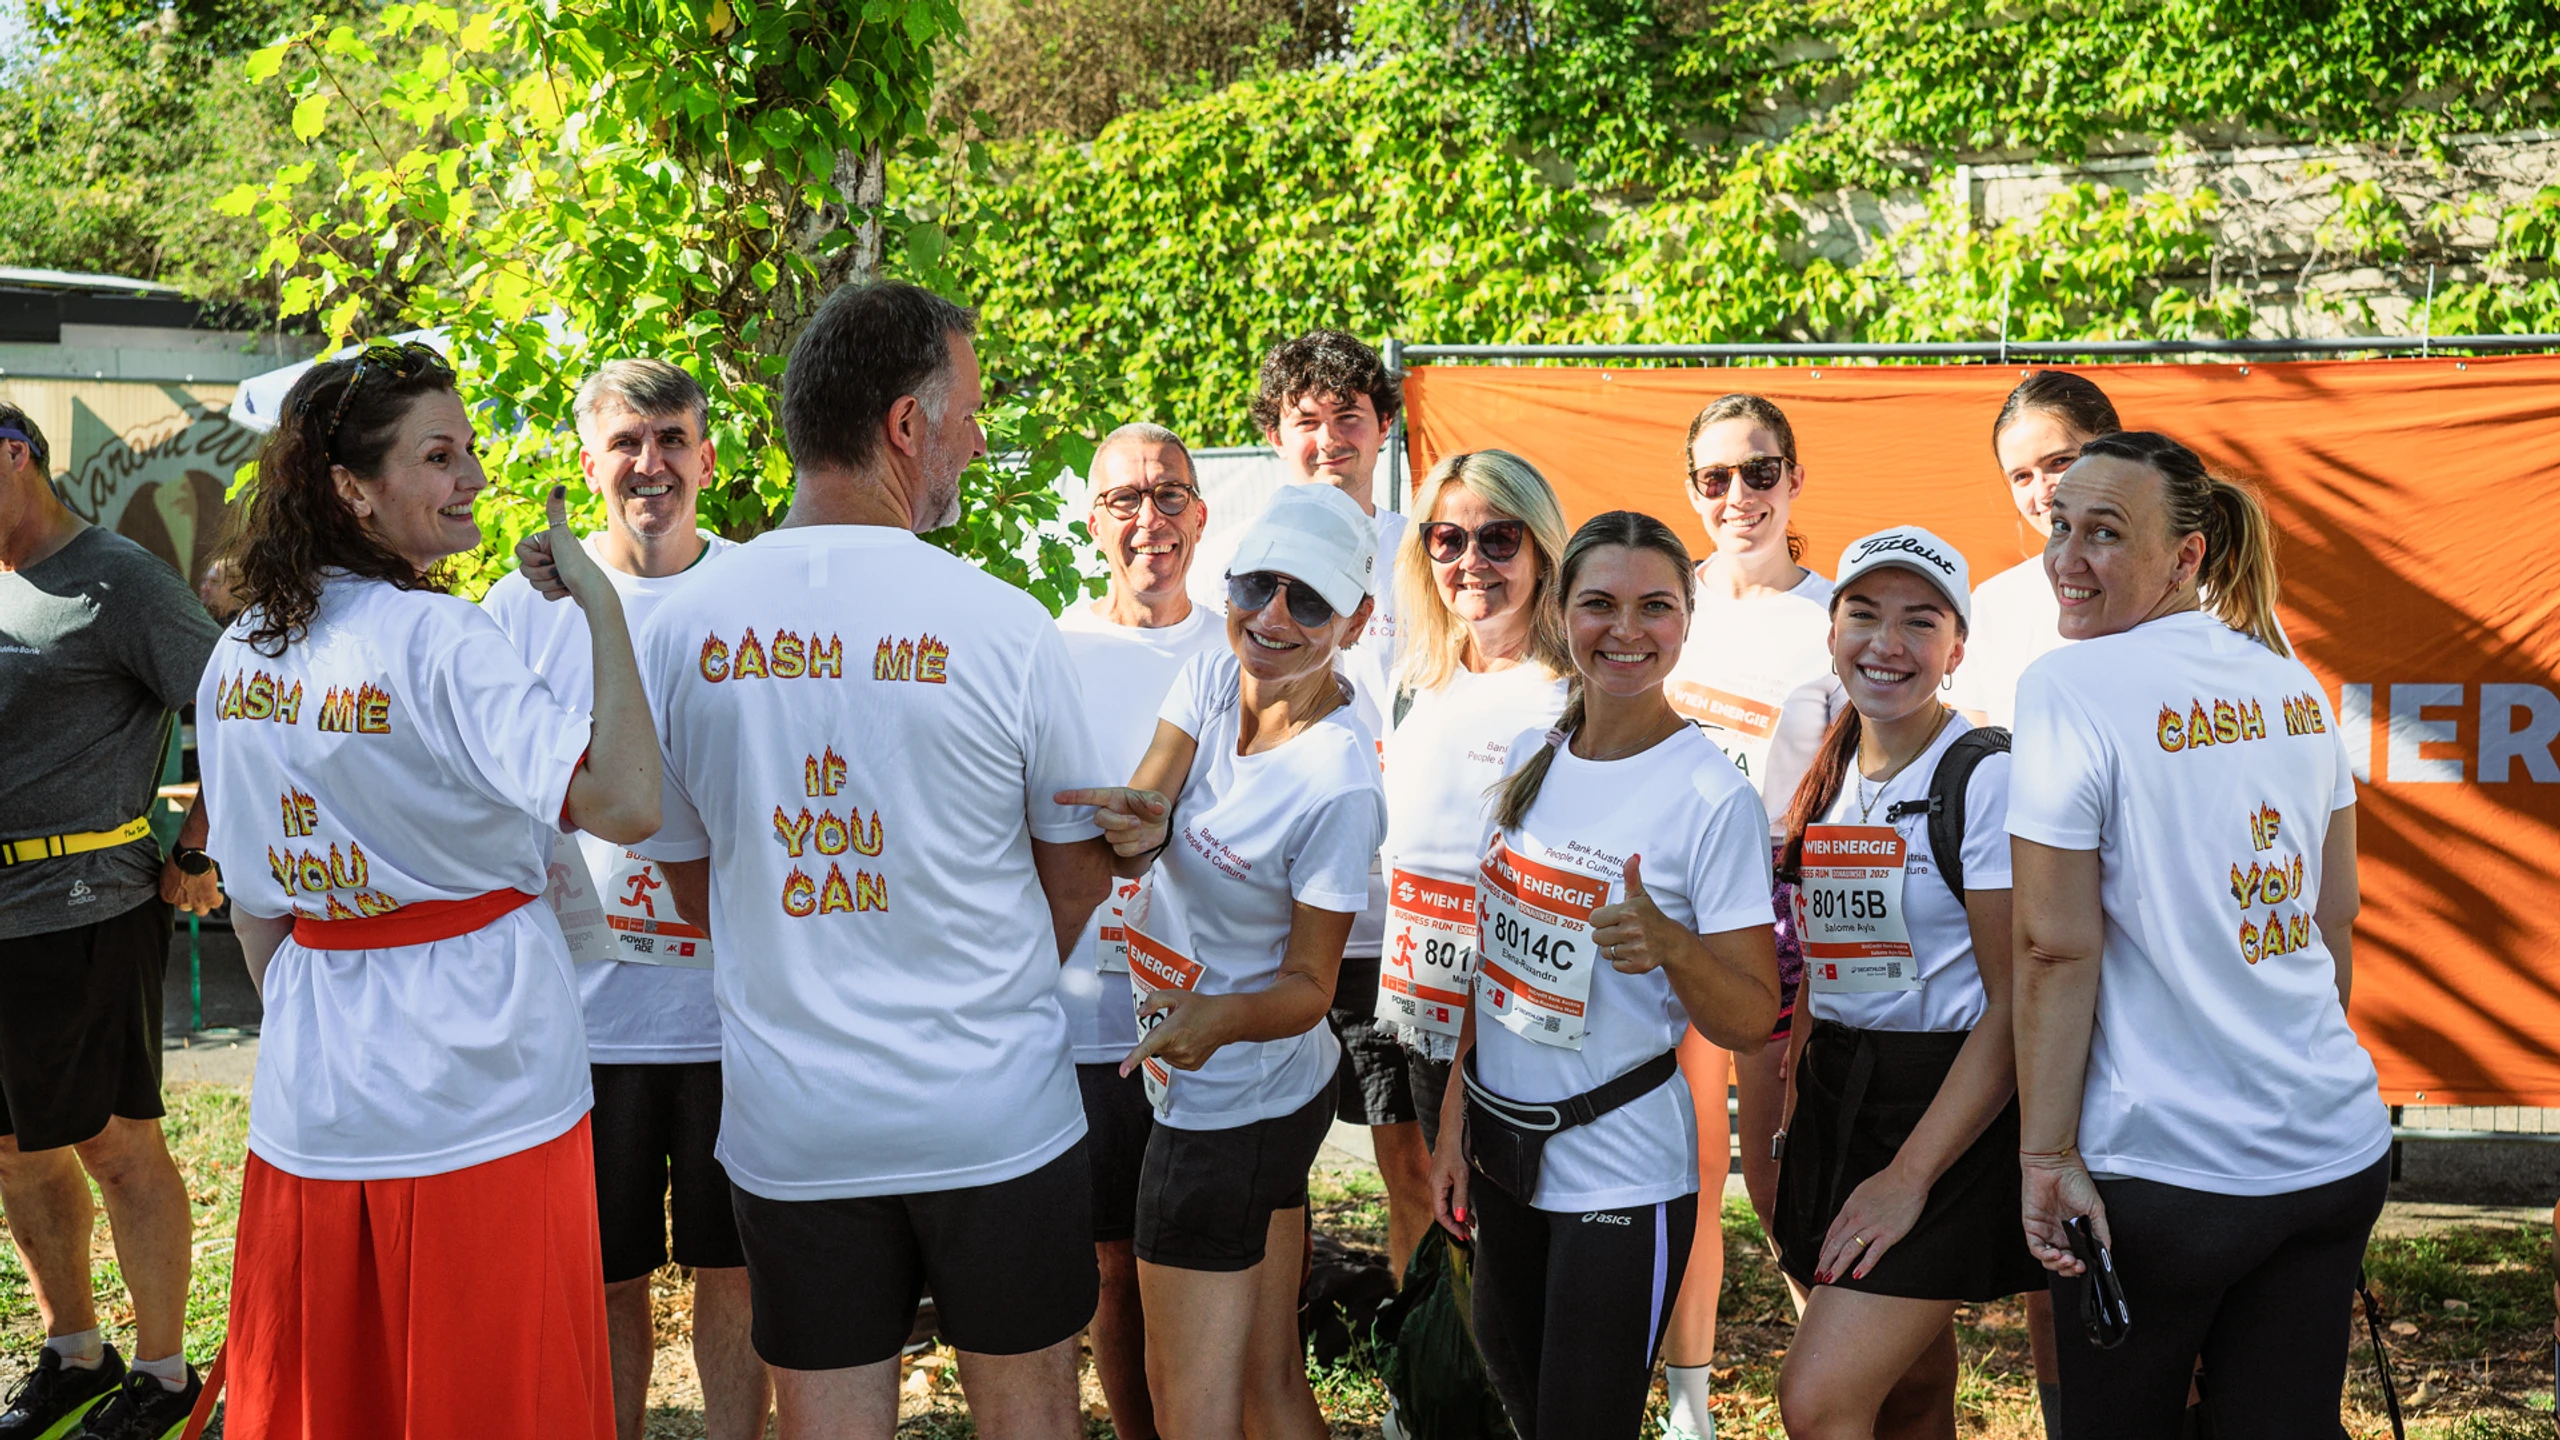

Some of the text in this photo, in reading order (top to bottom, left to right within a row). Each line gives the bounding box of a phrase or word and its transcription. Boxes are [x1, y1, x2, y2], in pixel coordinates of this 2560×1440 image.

[1851, 534, 1956, 575] Titleist
[700, 626, 949, 684] CASH ME
[318, 681, 391, 734] ME
[1675, 689, 1770, 729] WIEN ENERGIE
[2157, 690, 2326, 752] CASH ME
[805, 744, 847, 797] IF
[1467, 750, 1496, 763] People
[281, 785, 318, 837] IF
[2250, 801, 2280, 851] IF
[773, 805, 884, 858] YOU
[1804, 840, 1897, 855] WIEN ENERGIE
[1182, 826, 1246, 881] People & Culture
[1200, 827, 1252, 871] Bank Austria
[1544, 848, 1574, 862] People
[1575, 857, 1583, 866] &
[1567, 840, 1625, 868] Bank Austri
[268, 841, 369, 896] YOU
[1496, 858, 1595, 909] WIEN ENERGIE
[1815, 869, 1829, 878] RUN
[1870, 869, 1889, 878] 2025
[1906, 866, 1928, 875] ture
[2231, 853, 2303, 910] YOU
[68, 895, 96, 906] odlo
[782, 861, 888, 917] CAN
[1420, 890, 1459, 910] WIEN
[1813, 889, 1887, 918] 8015B
[1395, 909, 1429, 927] BUSINESS
[1431, 920, 1453, 932] RUN
[1561, 918, 1585, 932] 2025
[1824, 922, 1876, 933] Salome Ayla
[2239, 909, 2309, 965] CAN
[620, 934, 654, 945] POWER
[634, 944, 653, 953] ADE
[665, 944, 677, 952] AK
[1115, 945, 1128, 955] PO
[1425, 938, 1472, 972] 801
[1495, 912, 1576, 971] 8014C
[1130, 944, 1187, 988] ENERGIE
[1452, 975, 1470, 985] Mar
[1501, 948, 1557, 983] Elena-Ruxandra
[1392, 994, 1416, 1007] POWER
[1596, 1214, 1631, 1226] asics
